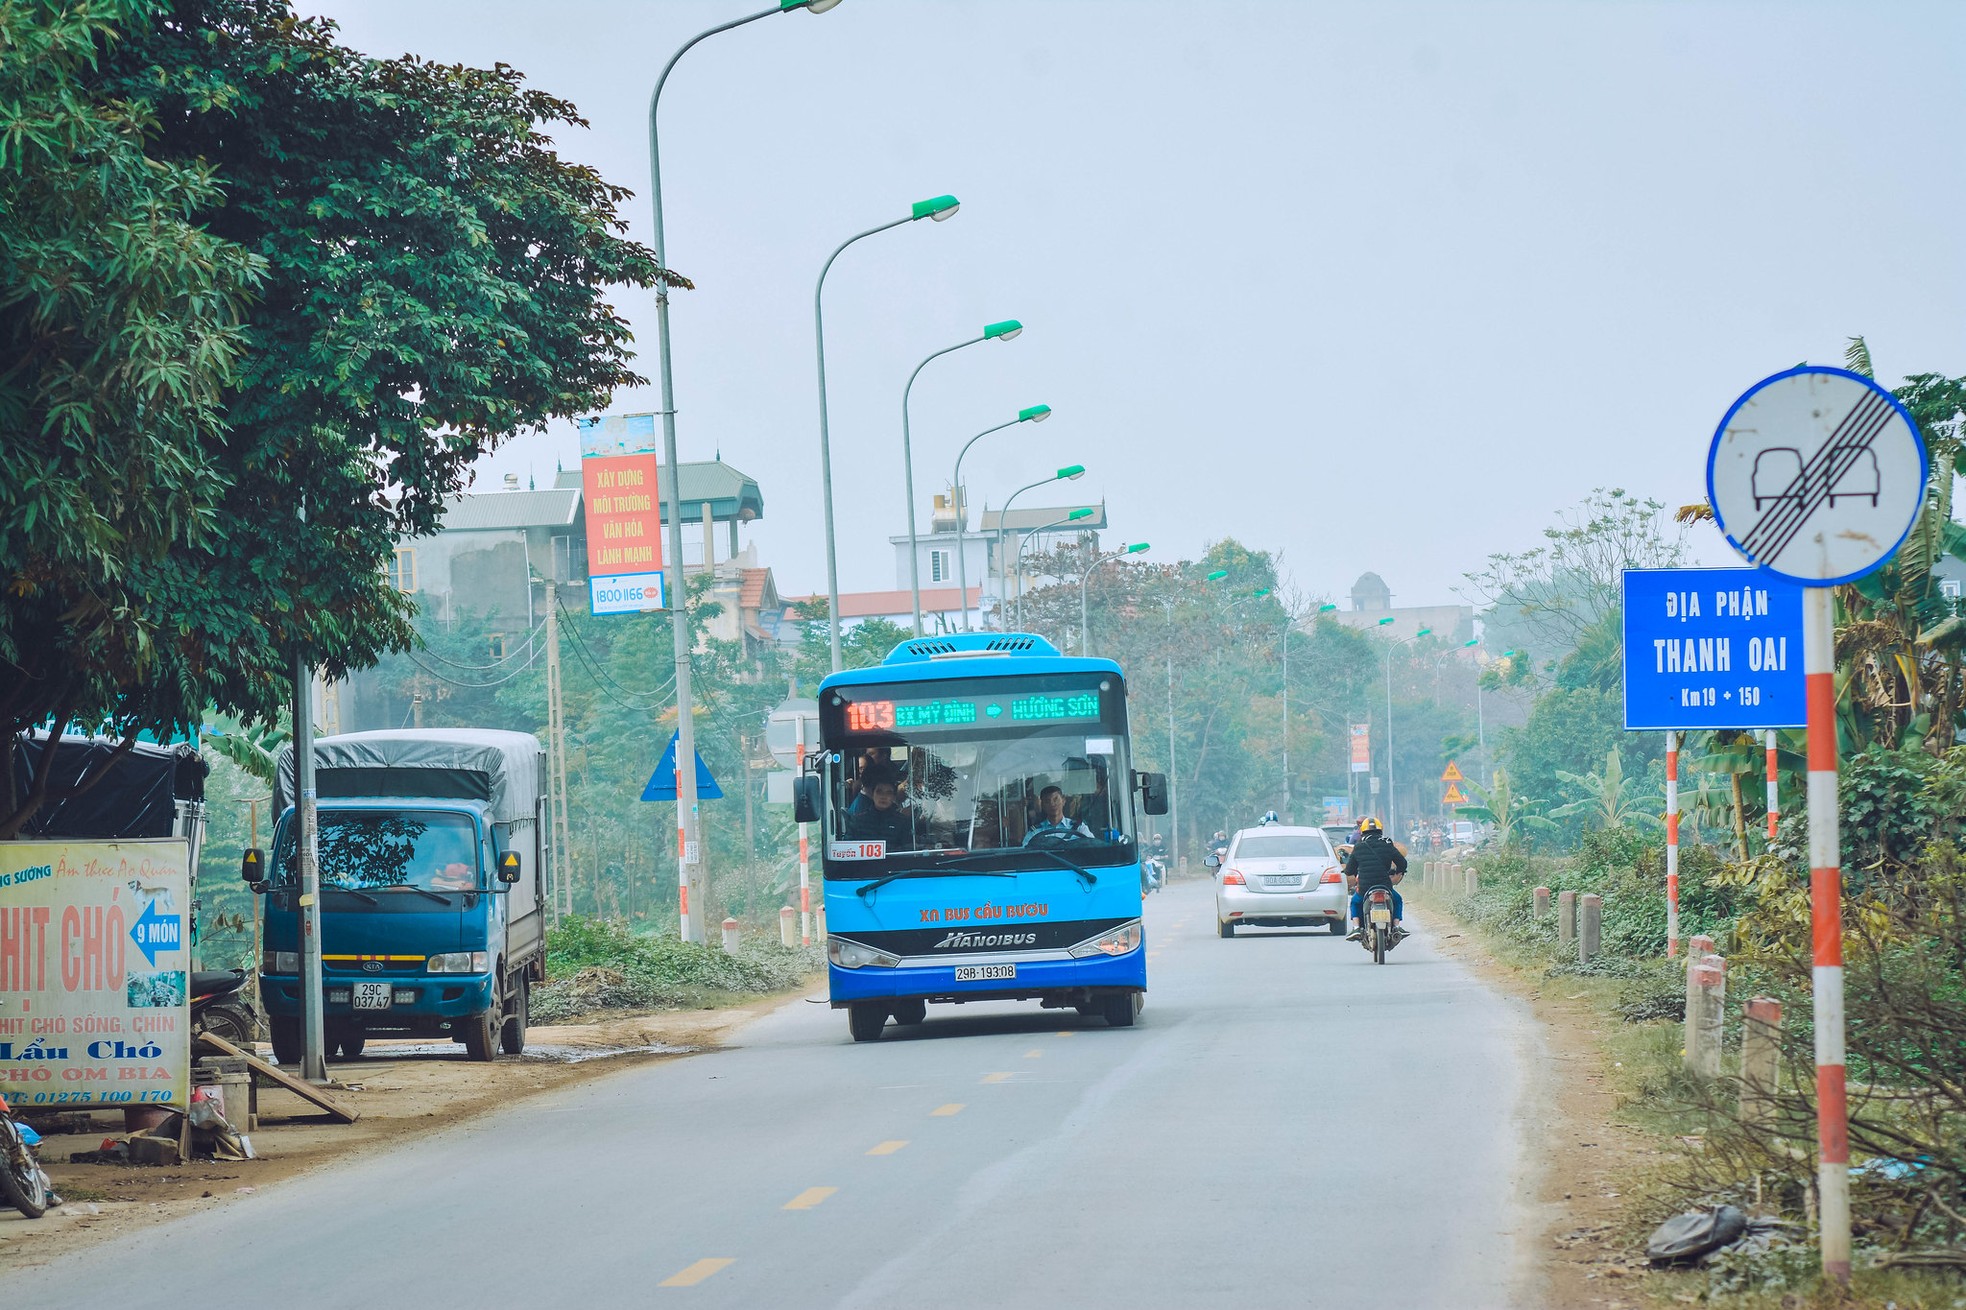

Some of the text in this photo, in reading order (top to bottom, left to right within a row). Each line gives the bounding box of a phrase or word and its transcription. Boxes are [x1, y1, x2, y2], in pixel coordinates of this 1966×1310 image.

[597, 469, 644, 490] XÂY DỰNG
[593, 491, 651, 514] MÔI TRƯỜNG
[603, 518, 644, 538] VĂN HÓA
[597, 546, 653, 566] LÀNH MẠNH
[596, 590, 622, 603] 1800
[623, 587, 643, 602] 1166
[1666, 585, 1768, 623] ĐỊA PHẬN
[1653, 637, 1787, 673] THANH OAI
[1067, 693, 1099, 717] SƠN
[1738, 687, 1760, 706] 150
[847, 701, 895, 730] 103
[859, 844, 882, 858] 103
[944, 907, 971, 921] BUS
[61, 887, 125, 993] CHÓ
[137, 918, 178, 943] 9 MÓN
[933, 931, 1037, 948] HANOIBUS
[362, 984, 382, 996] 29C
[31, 1015, 66, 1034] CHÓ
[72, 1011, 126, 1034] SỐNG,
[132, 1014, 175, 1034] CHÍN
[0, 1037, 162, 1061] Lẩu Chó
[61, 1067, 108, 1081] OM
[117, 1066, 172, 1081] BIA
[34, 1091, 92, 1104] 01275
[99, 1091, 132, 1103] 100
[140, 1089, 173, 1102] 170
